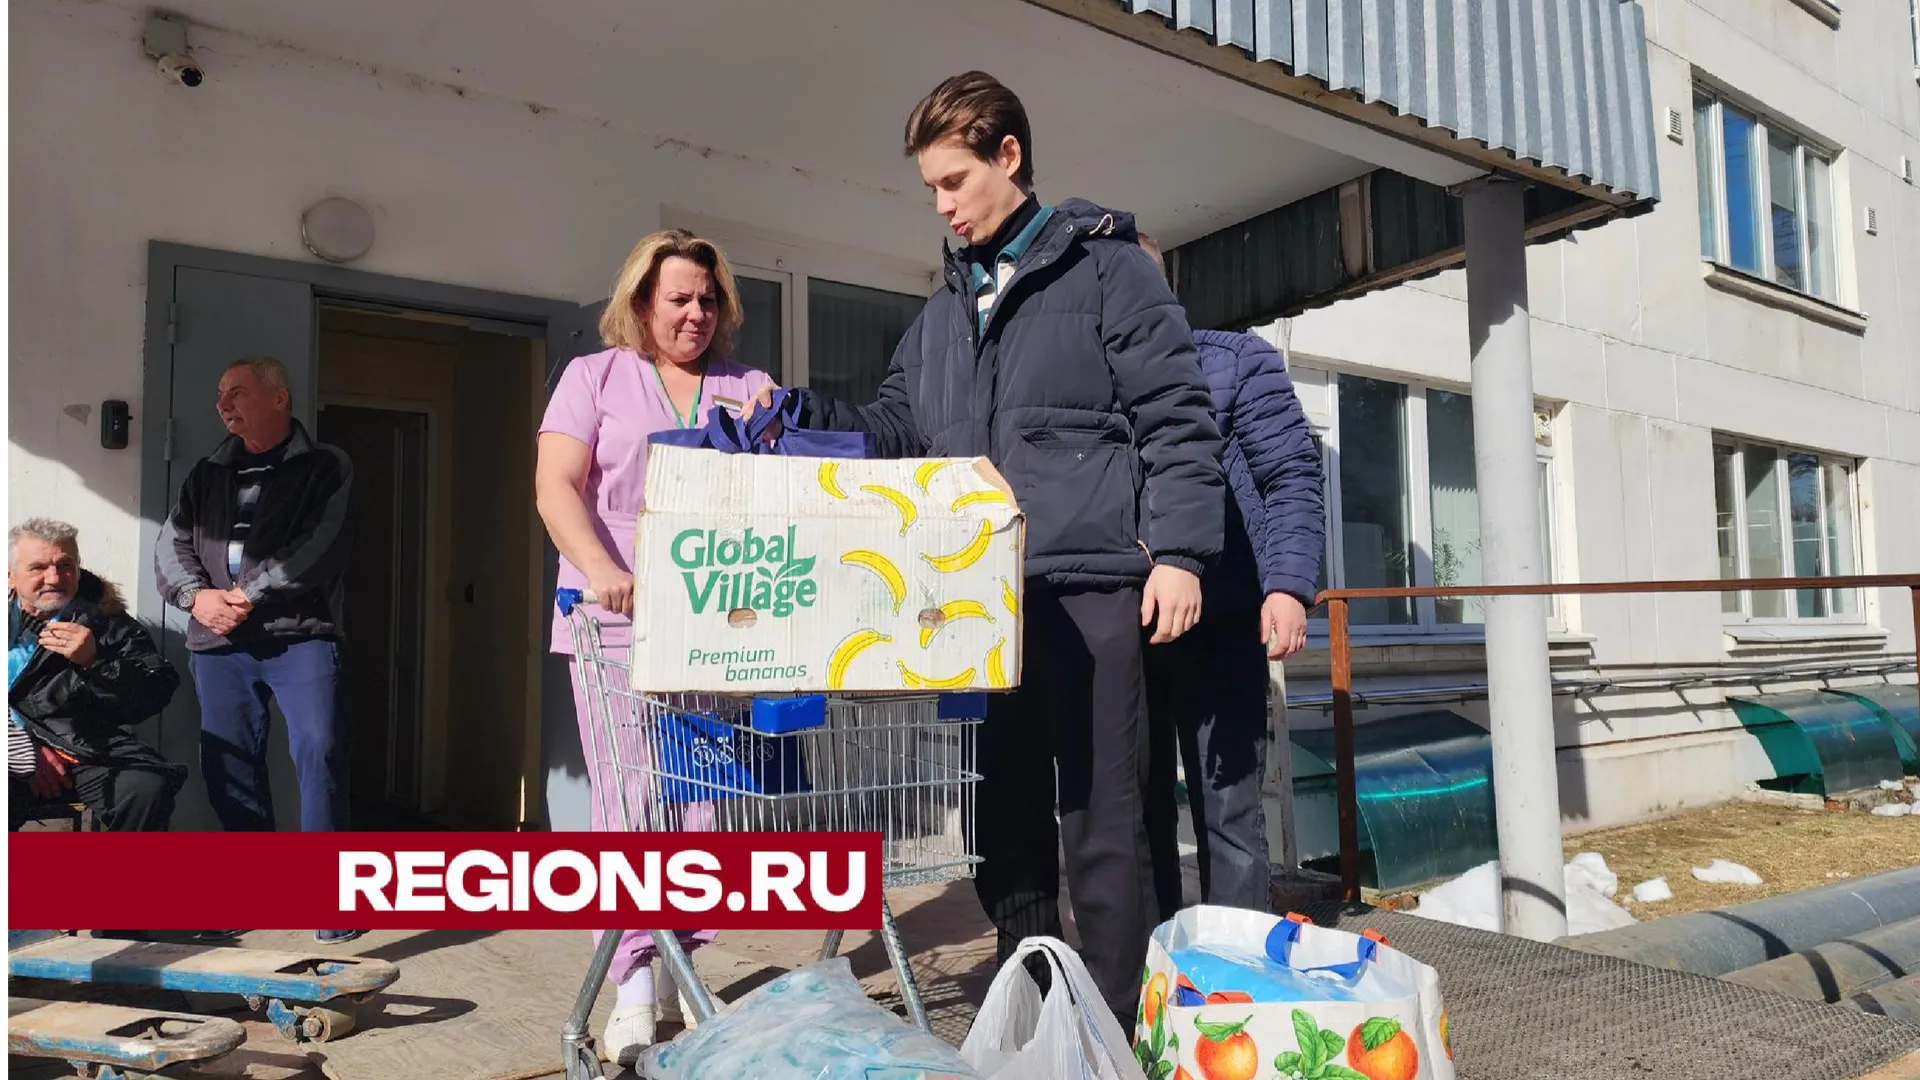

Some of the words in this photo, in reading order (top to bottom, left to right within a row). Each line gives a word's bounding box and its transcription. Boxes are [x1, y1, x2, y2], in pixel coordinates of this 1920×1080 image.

[681, 569, 817, 617] Village
[688, 647, 775, 666] Premium
[725, 664, 807, 682] bananas
